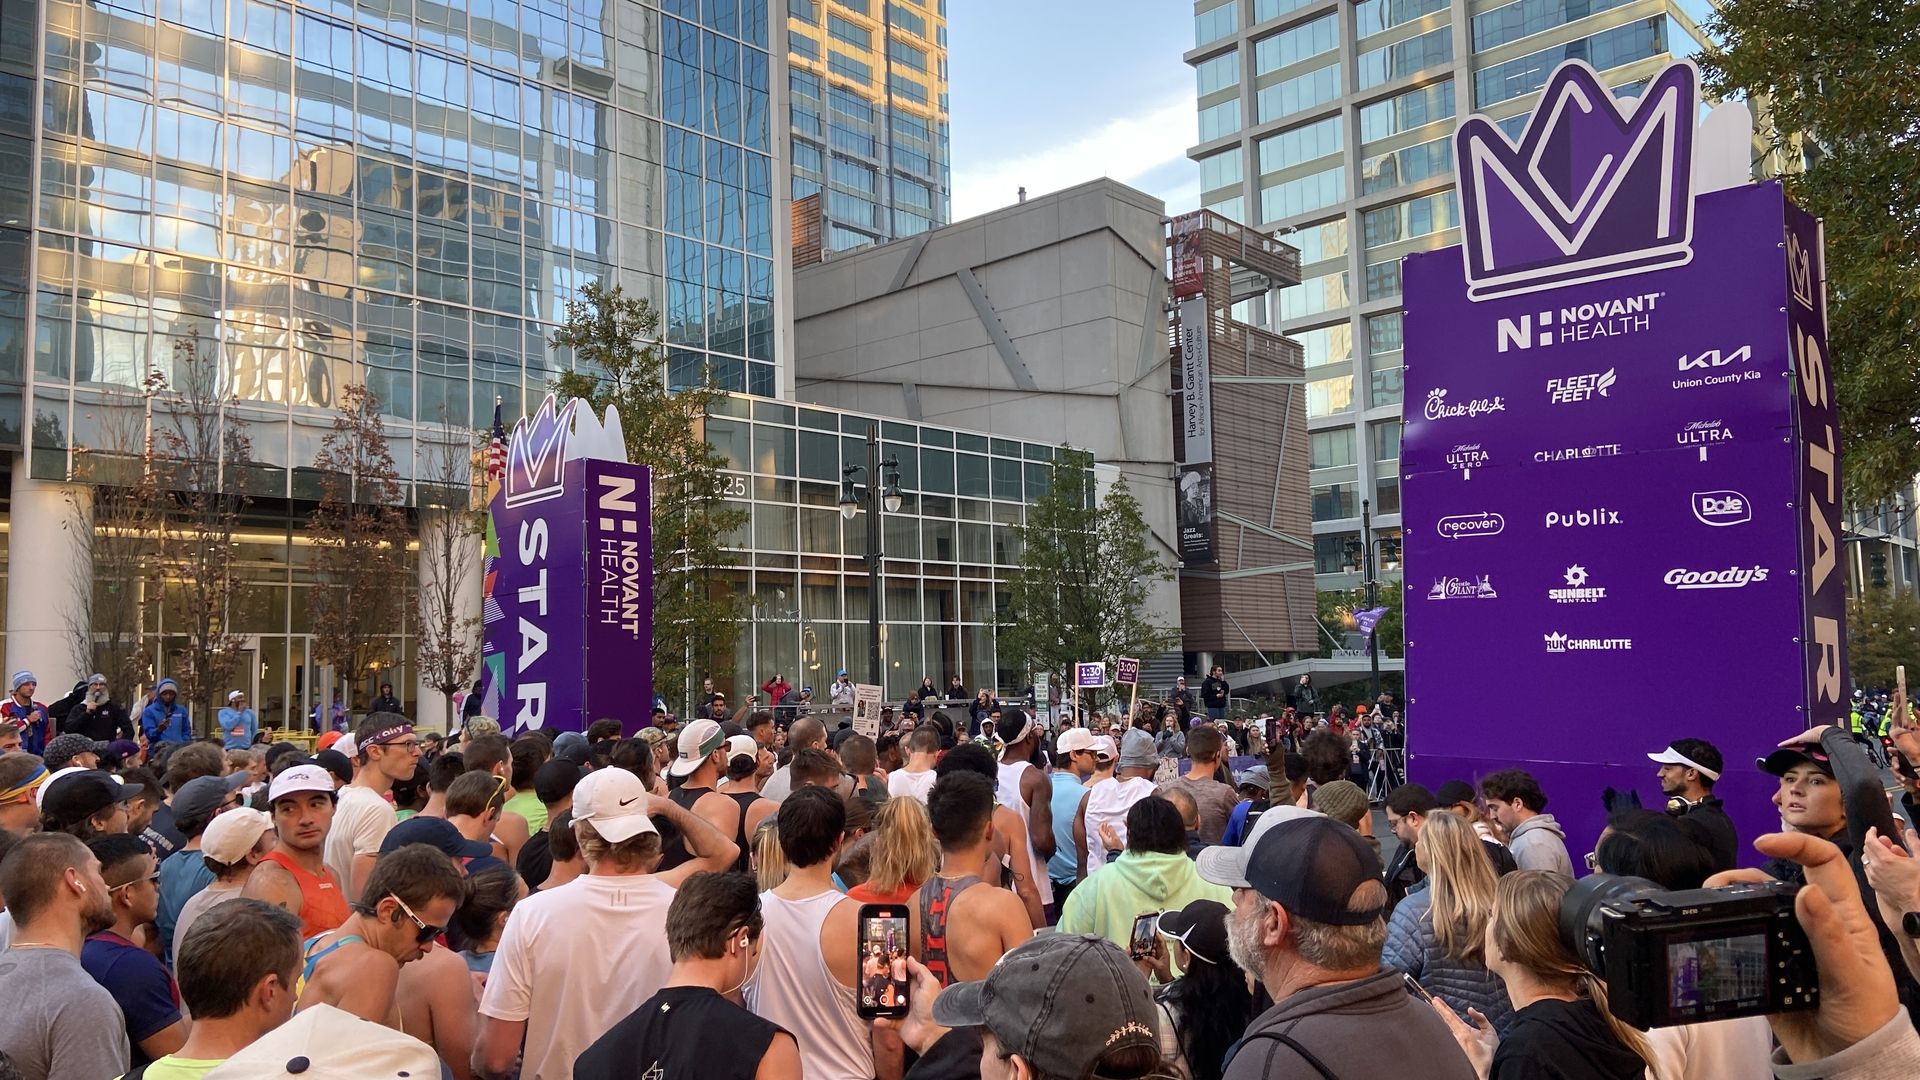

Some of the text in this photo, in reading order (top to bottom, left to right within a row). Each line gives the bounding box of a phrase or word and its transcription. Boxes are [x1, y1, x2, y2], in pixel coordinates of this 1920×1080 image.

[1561, 292, 1660, 325] NOVANT
[1561, 314, 1650, 344] HEALTH
[1184, 328, 1198, 438] Harvey B. Gantt Center
[1546, 373, 1600, 393] FLEET
[1672, 370, 1761, 389] Union County Kia
[1552, 387, 1595, 404] FEET
[1676, 428, 1733, 444] ULTRA
[1446, 451, 1490, 464] ULTRA
[1452, 461, 1482, 470] ZERO
[1702, 496, 1743, 515] Dole
[1444, 520, 1498, 531] recover
[1545, 508, 1620, 528] Publix
[1796, 322, 1845, 729] STAR
[600, 538, 619, 624] HEALTH
[1663, 565, 1770, 590] Goody's
[621, 540, 639, 635] NOVANT
[1548, 588, 1606, 599] SUNBELT
[1546, 639, 1632, 650] RUN CHARLOTTE
[1081, 667, 1101, 677] 1:30
[1119, 662, 1137, 673] 3:00
